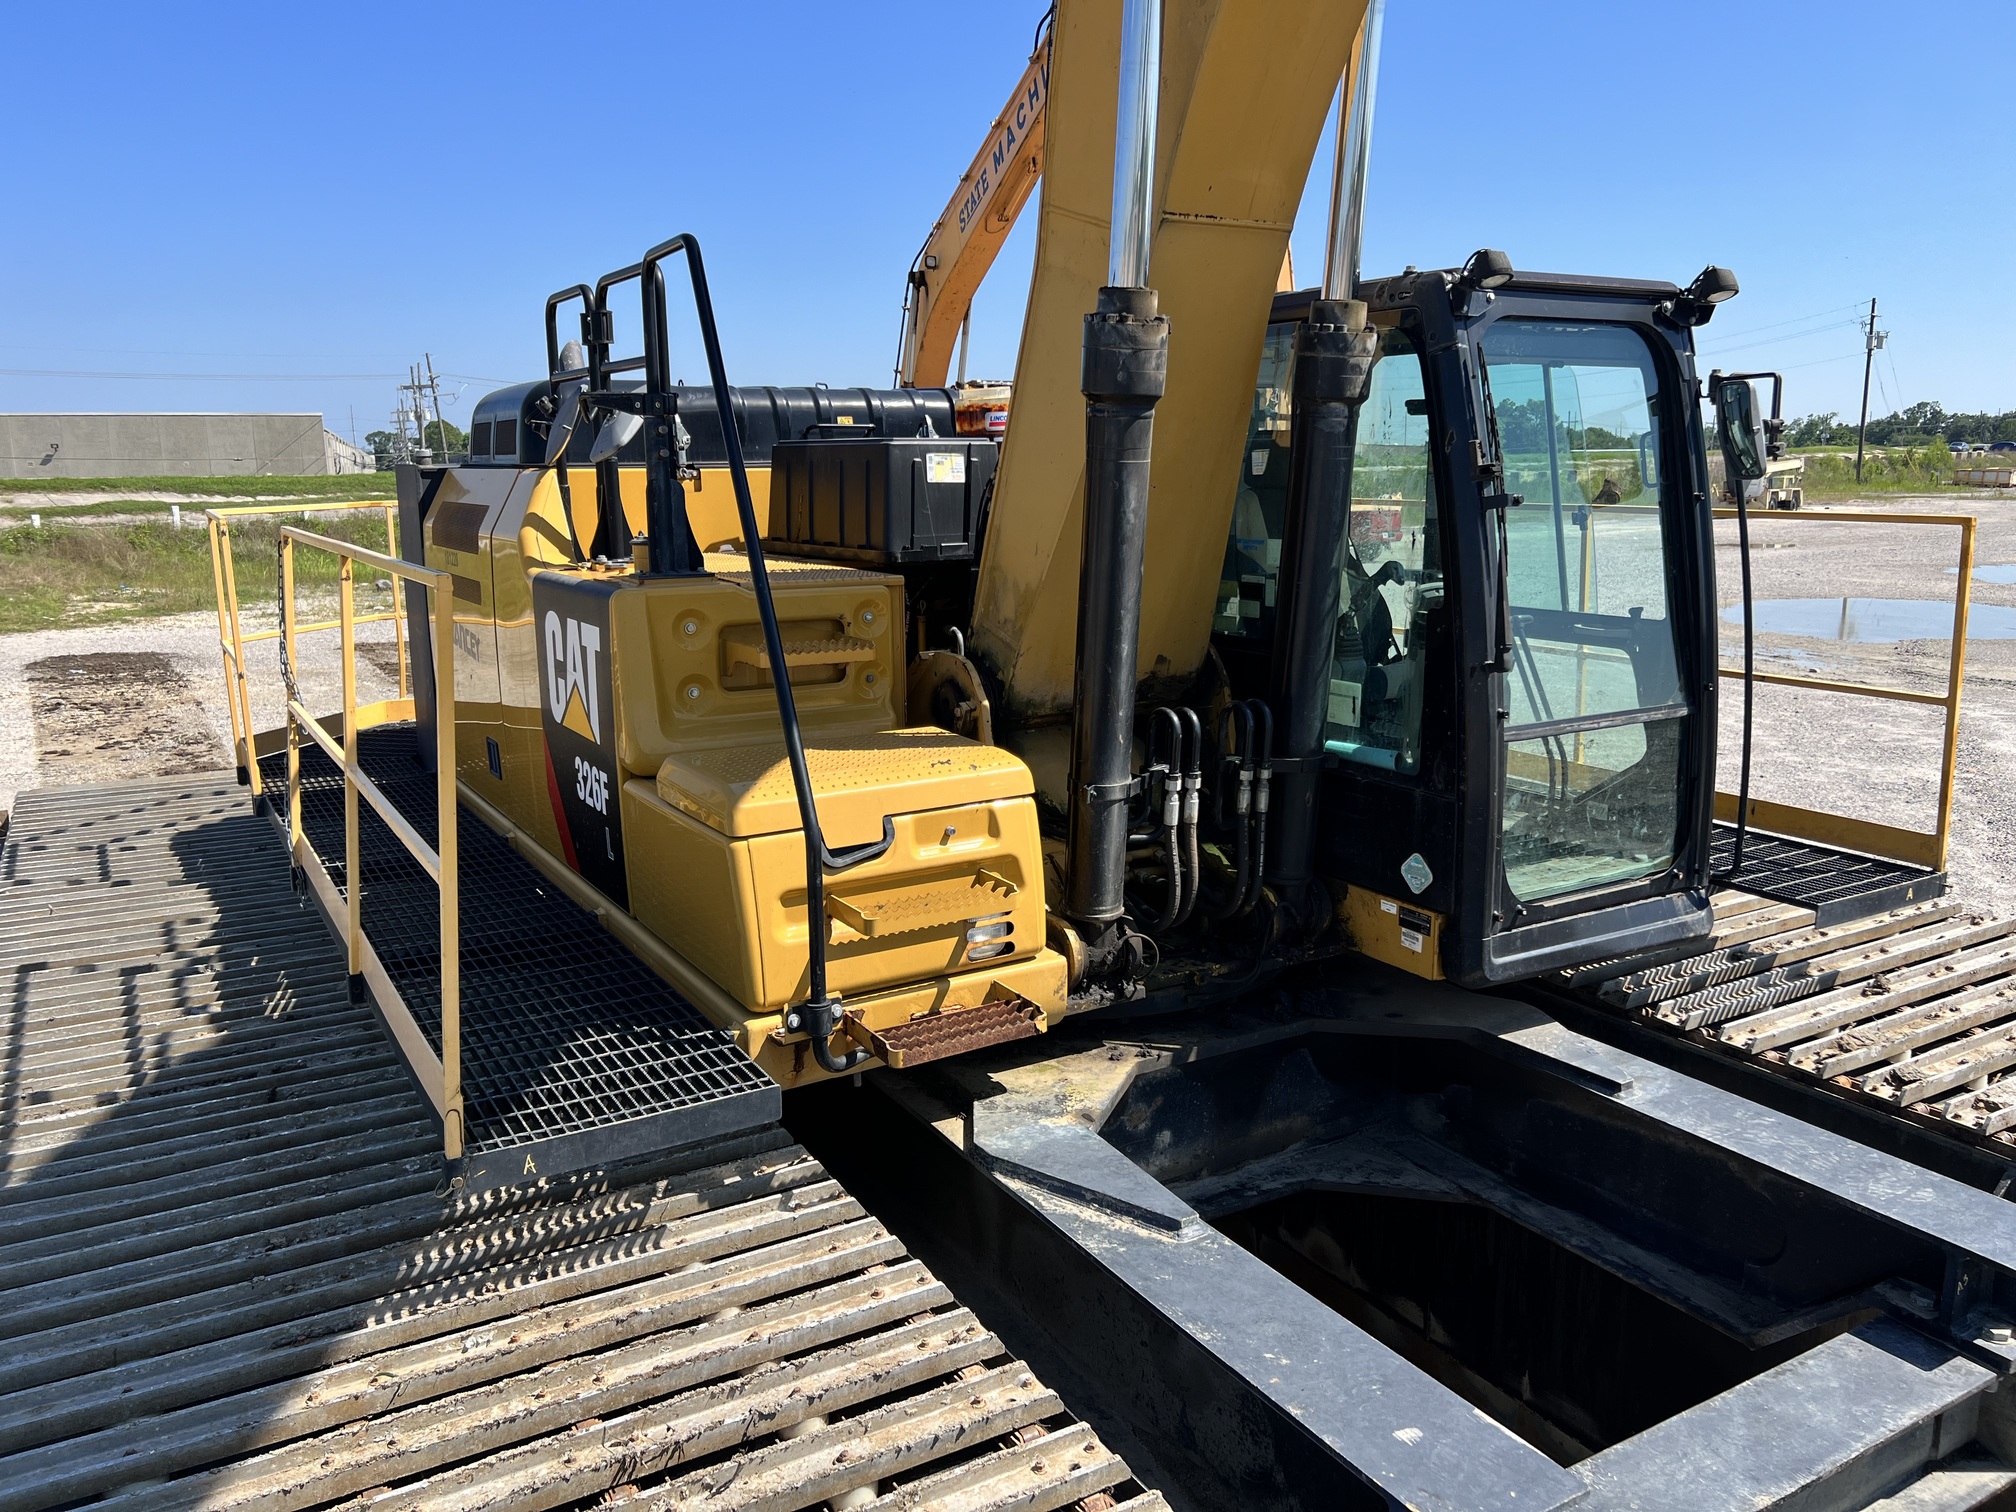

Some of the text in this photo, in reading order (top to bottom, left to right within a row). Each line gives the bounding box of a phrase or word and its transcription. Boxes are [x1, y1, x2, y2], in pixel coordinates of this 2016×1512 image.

[958, 167, 989, 234] STATE
[544, 609, 601, 746] CAT
[574, 755, 610, 816] 326F
[604, 826, 615, 861] L
[1905, 887, 1914, 901] A
[523, 1153, 537, 1175] A
